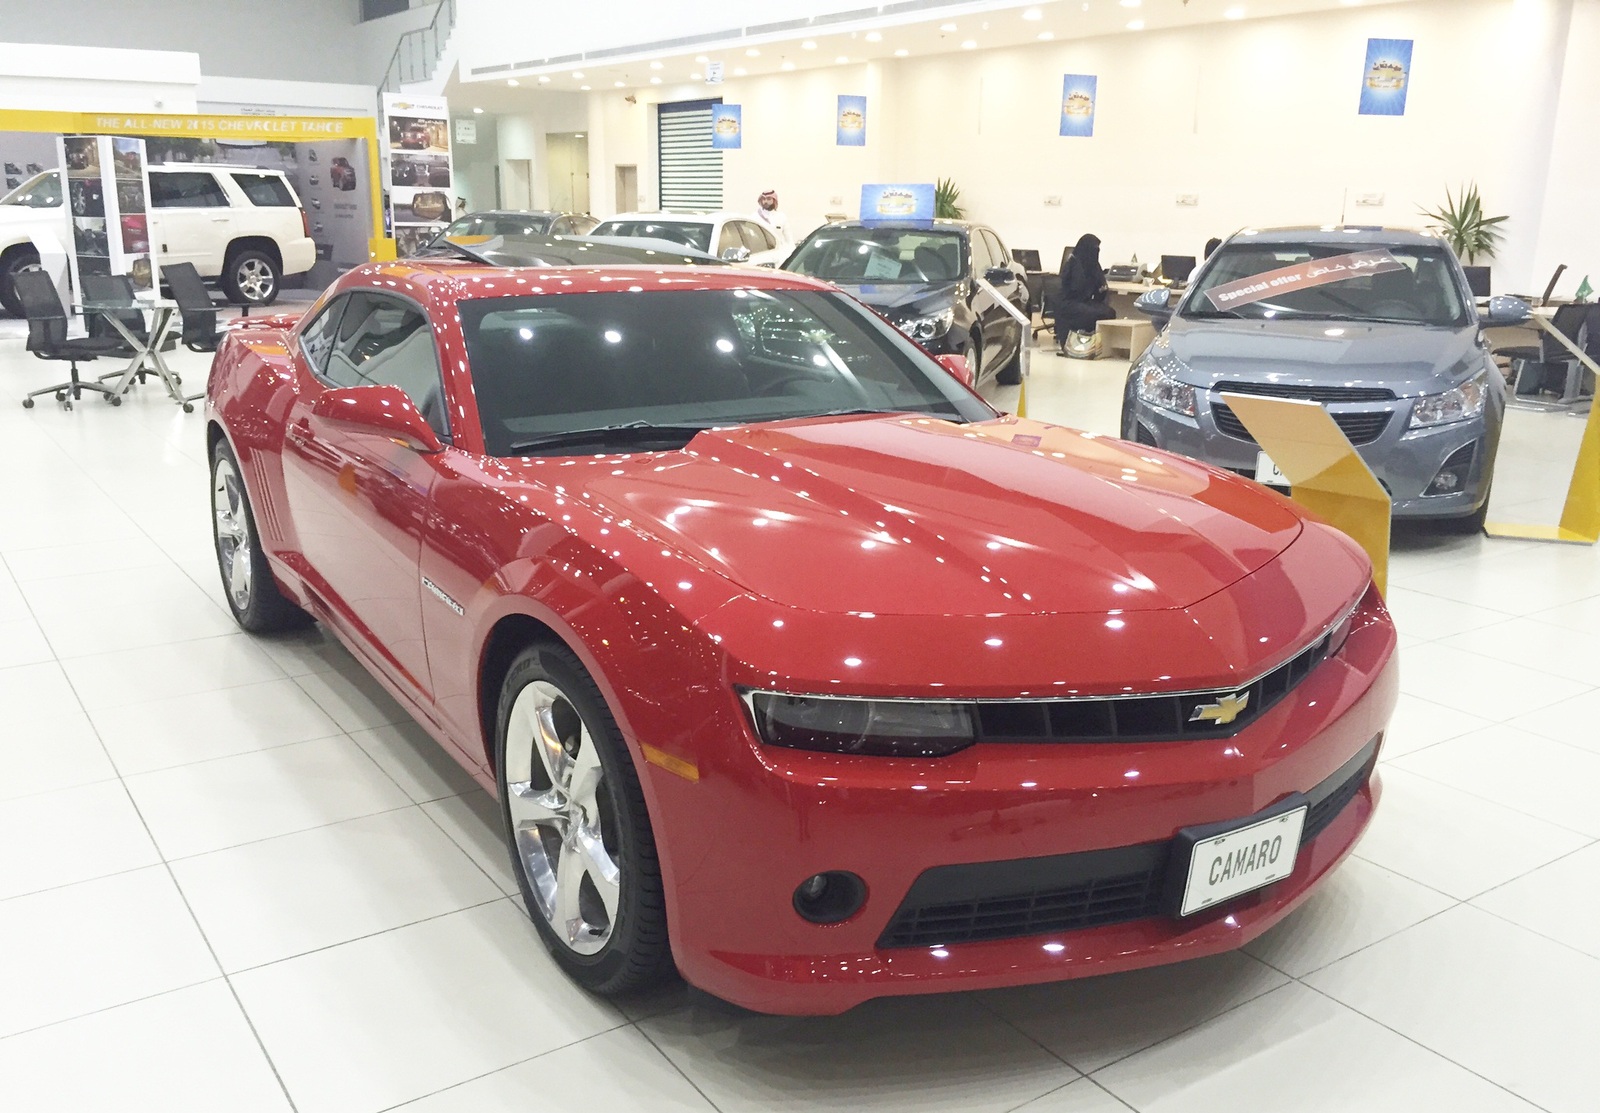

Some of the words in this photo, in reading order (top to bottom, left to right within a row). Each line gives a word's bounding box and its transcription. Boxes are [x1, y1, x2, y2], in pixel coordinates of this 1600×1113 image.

[96, 117, 120, 129] THE
[123, 118, 183, 130] ALL-NEW
[218, 120, 297, 132] CHEVROLET
[301, 121, 344, 133] TAHOE
[1217, 281, 1270, 302] Special
[1270, 273, 1302, 288] offer
[1208, 835, 1282, 886] CAMARO
